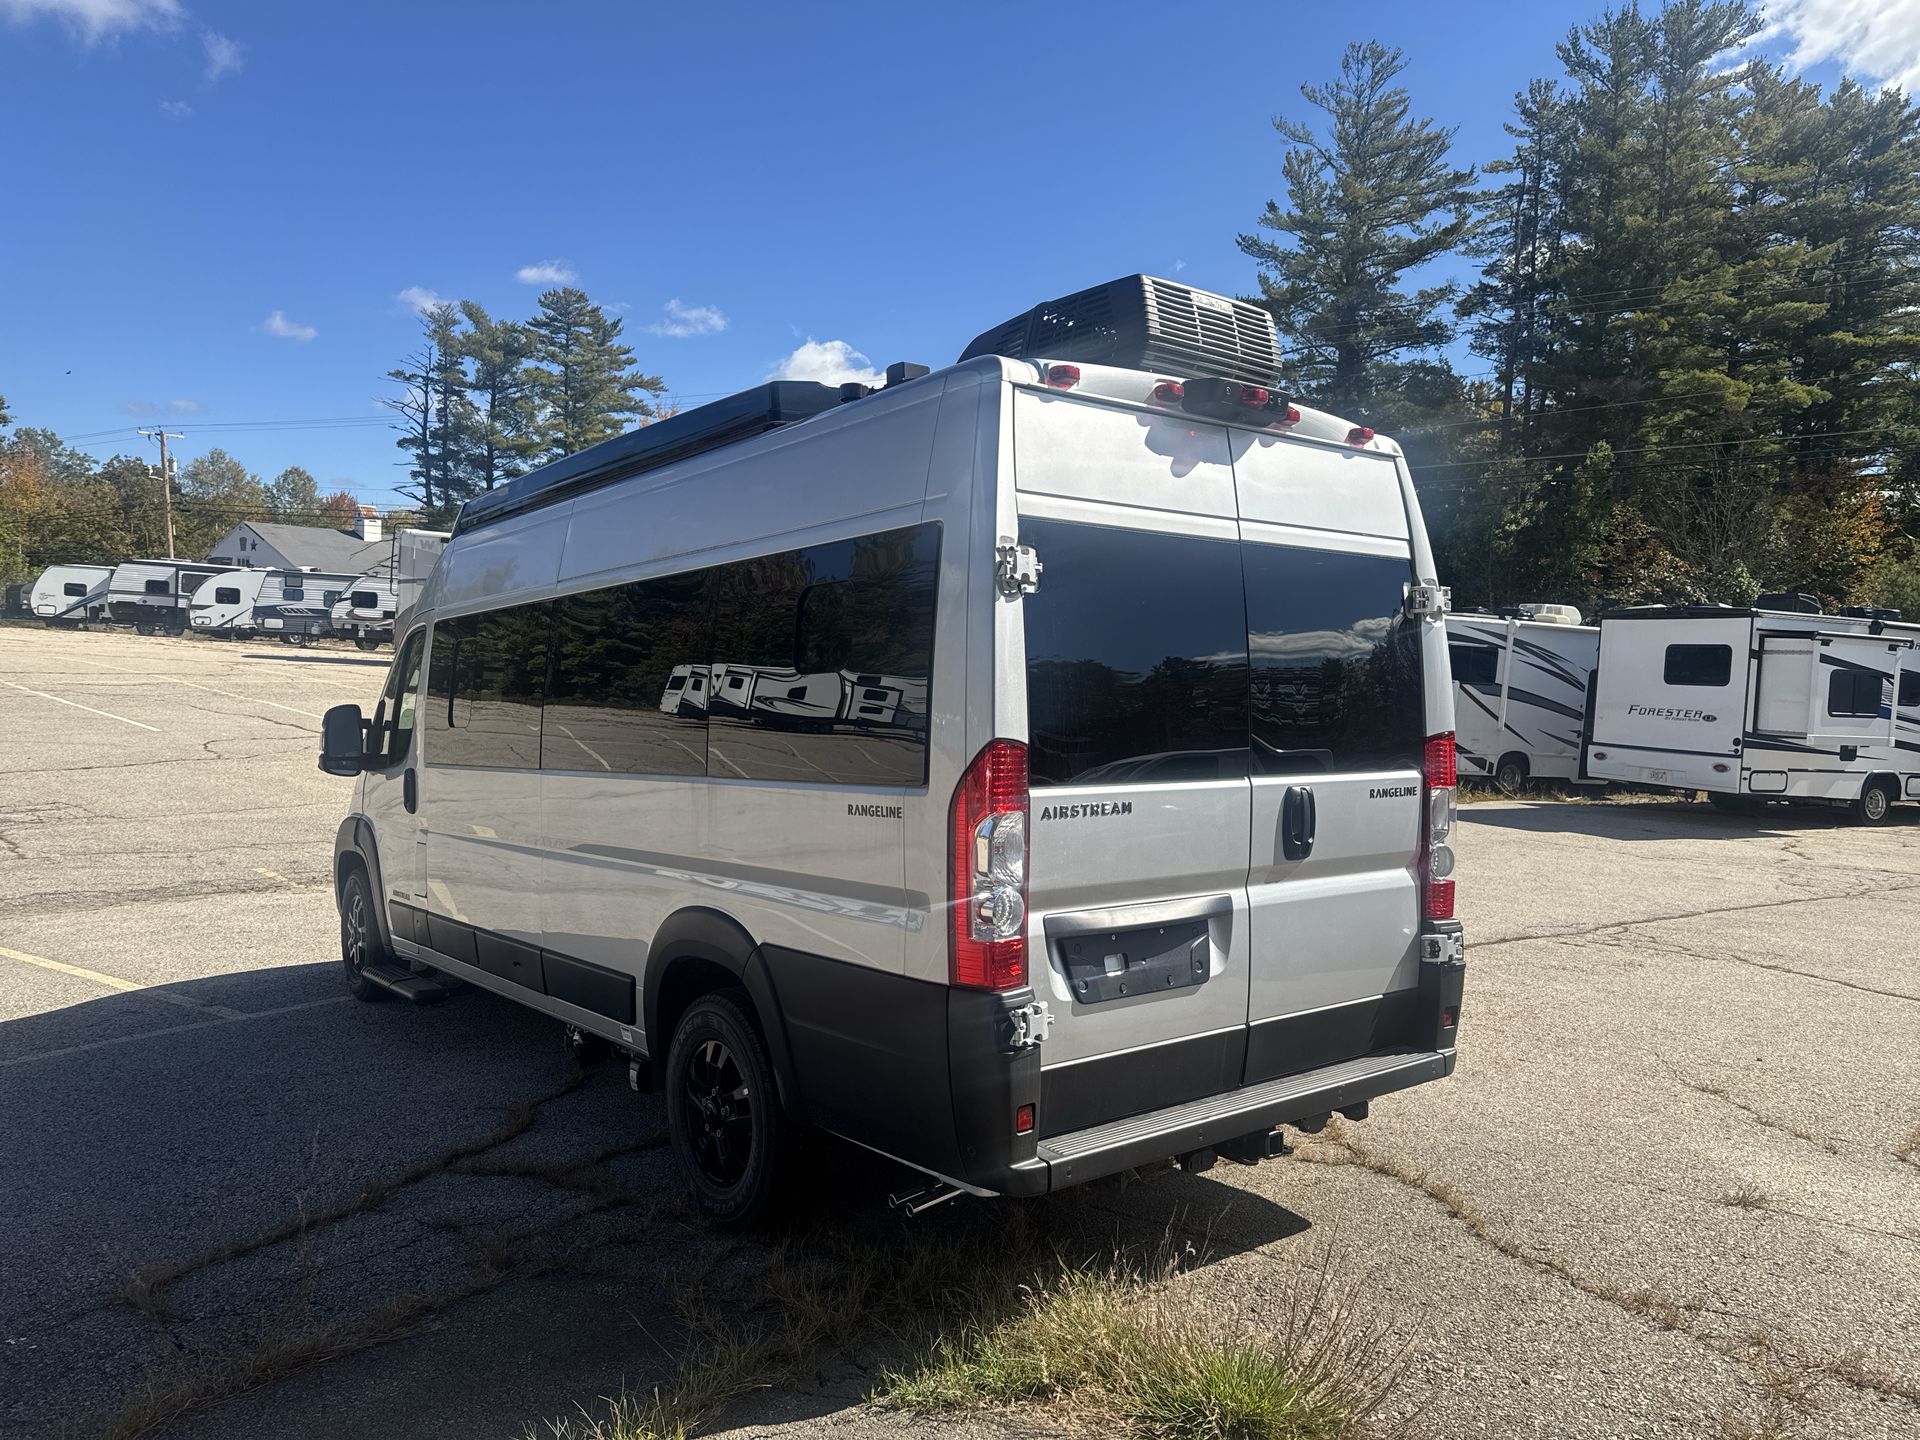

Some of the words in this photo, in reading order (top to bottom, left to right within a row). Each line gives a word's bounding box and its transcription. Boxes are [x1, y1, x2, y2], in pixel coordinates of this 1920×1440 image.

[1627, 704, 1703, 719] FORESTER
[1369, 786, 1418, 799] RANGELINE
[847, 803, 903, 819] RANGELINE
[1040, 801, 1133, 821] AIRSTREAM
